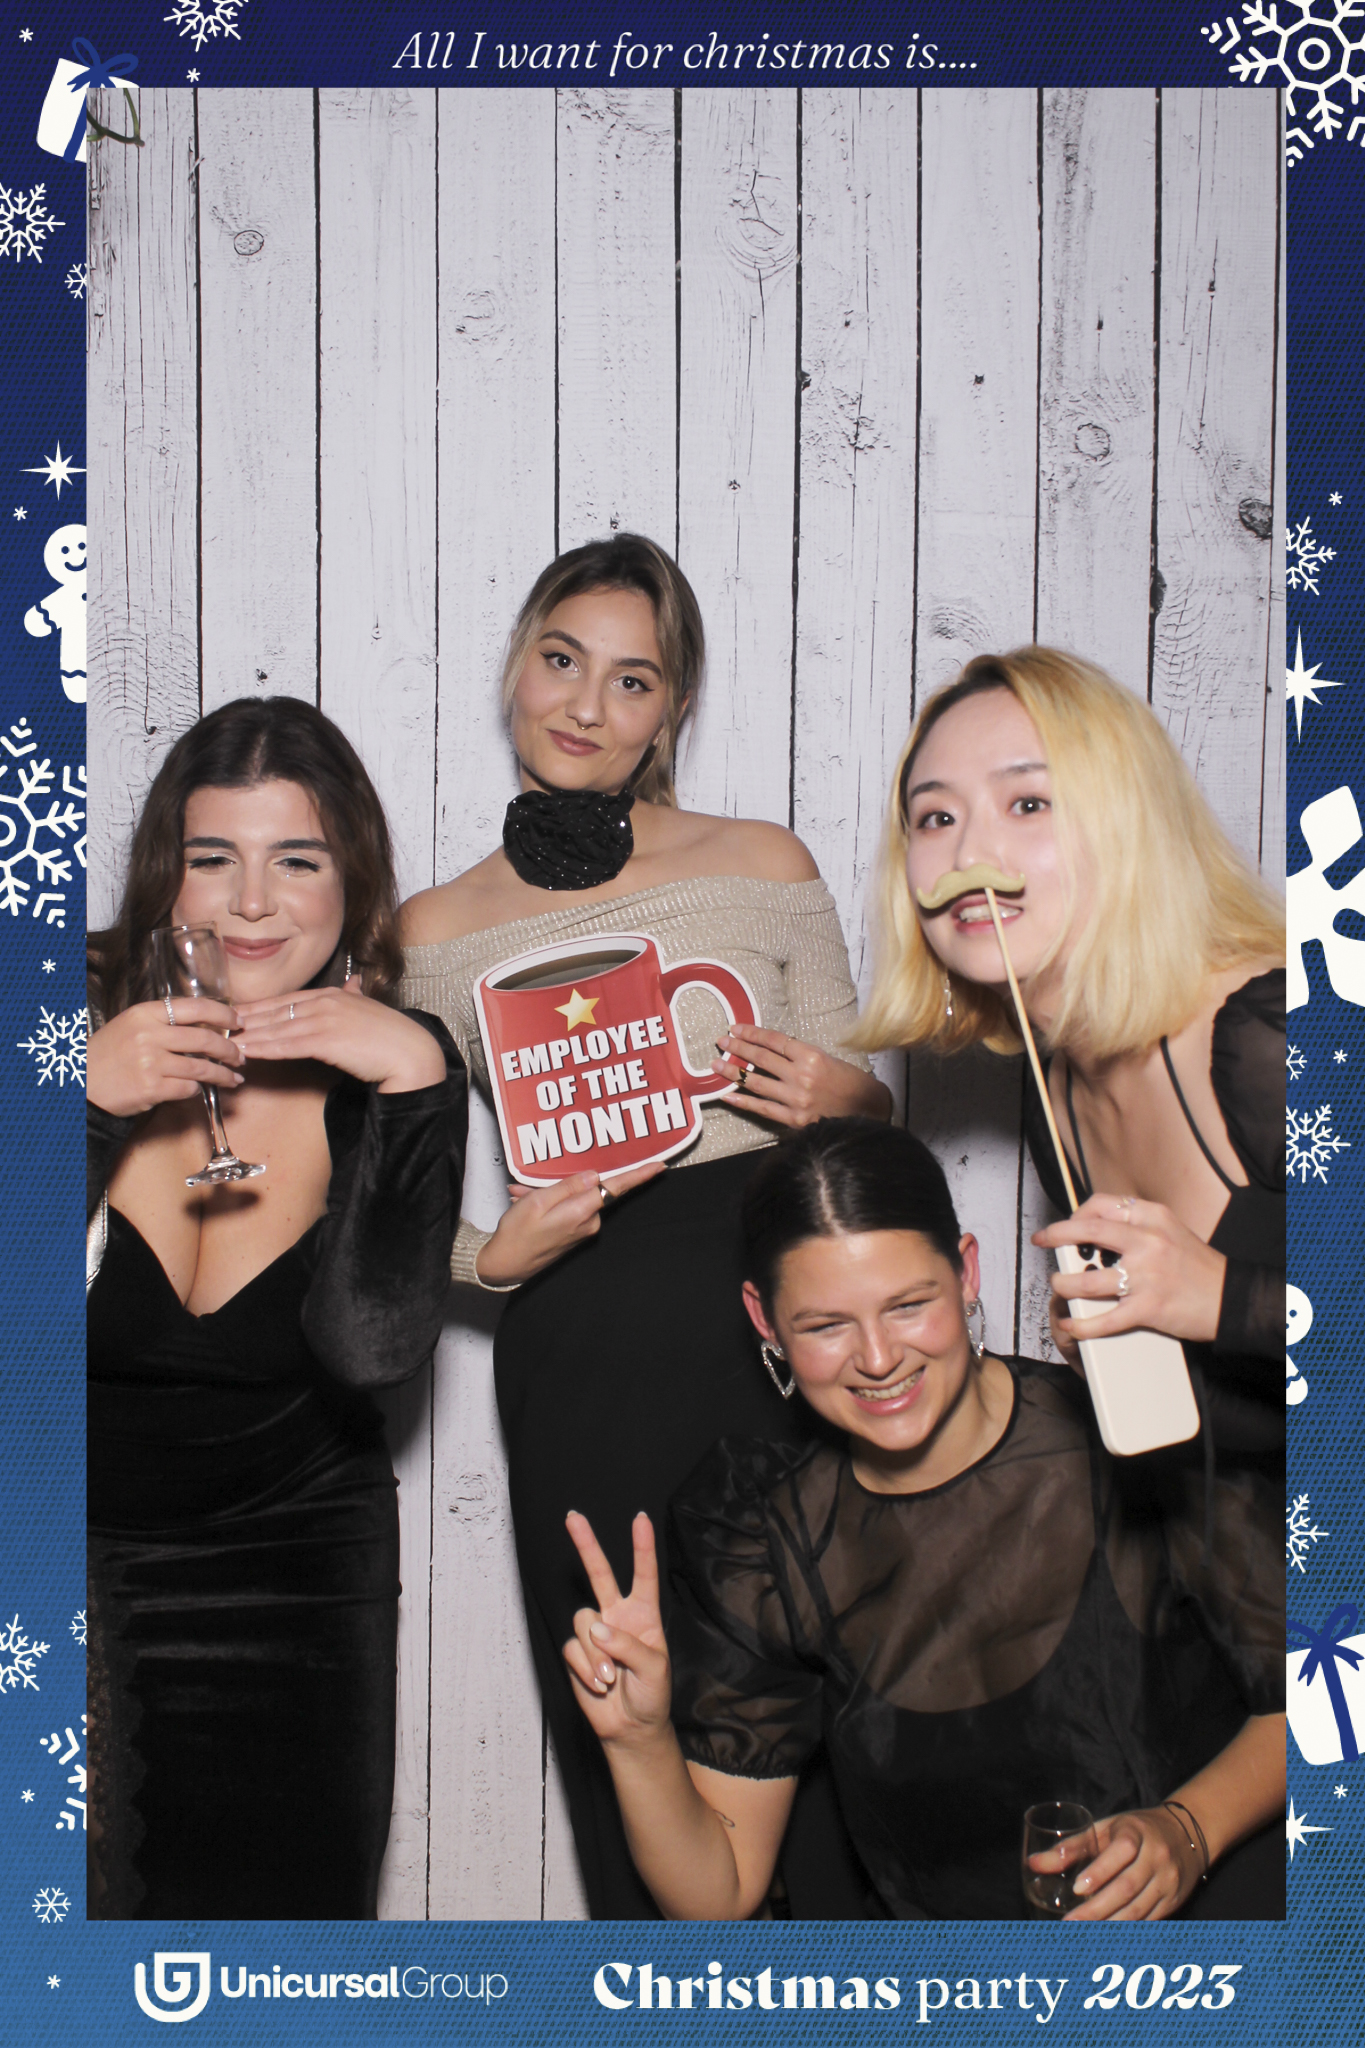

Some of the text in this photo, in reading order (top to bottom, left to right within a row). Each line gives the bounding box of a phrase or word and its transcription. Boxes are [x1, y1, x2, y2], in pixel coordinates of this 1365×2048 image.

[500, 1015, 668, 1082] EMPLOYEE
[535, 1058, 649, 1111] OF THE
[516, 1088, 689, 1166] MONTH
